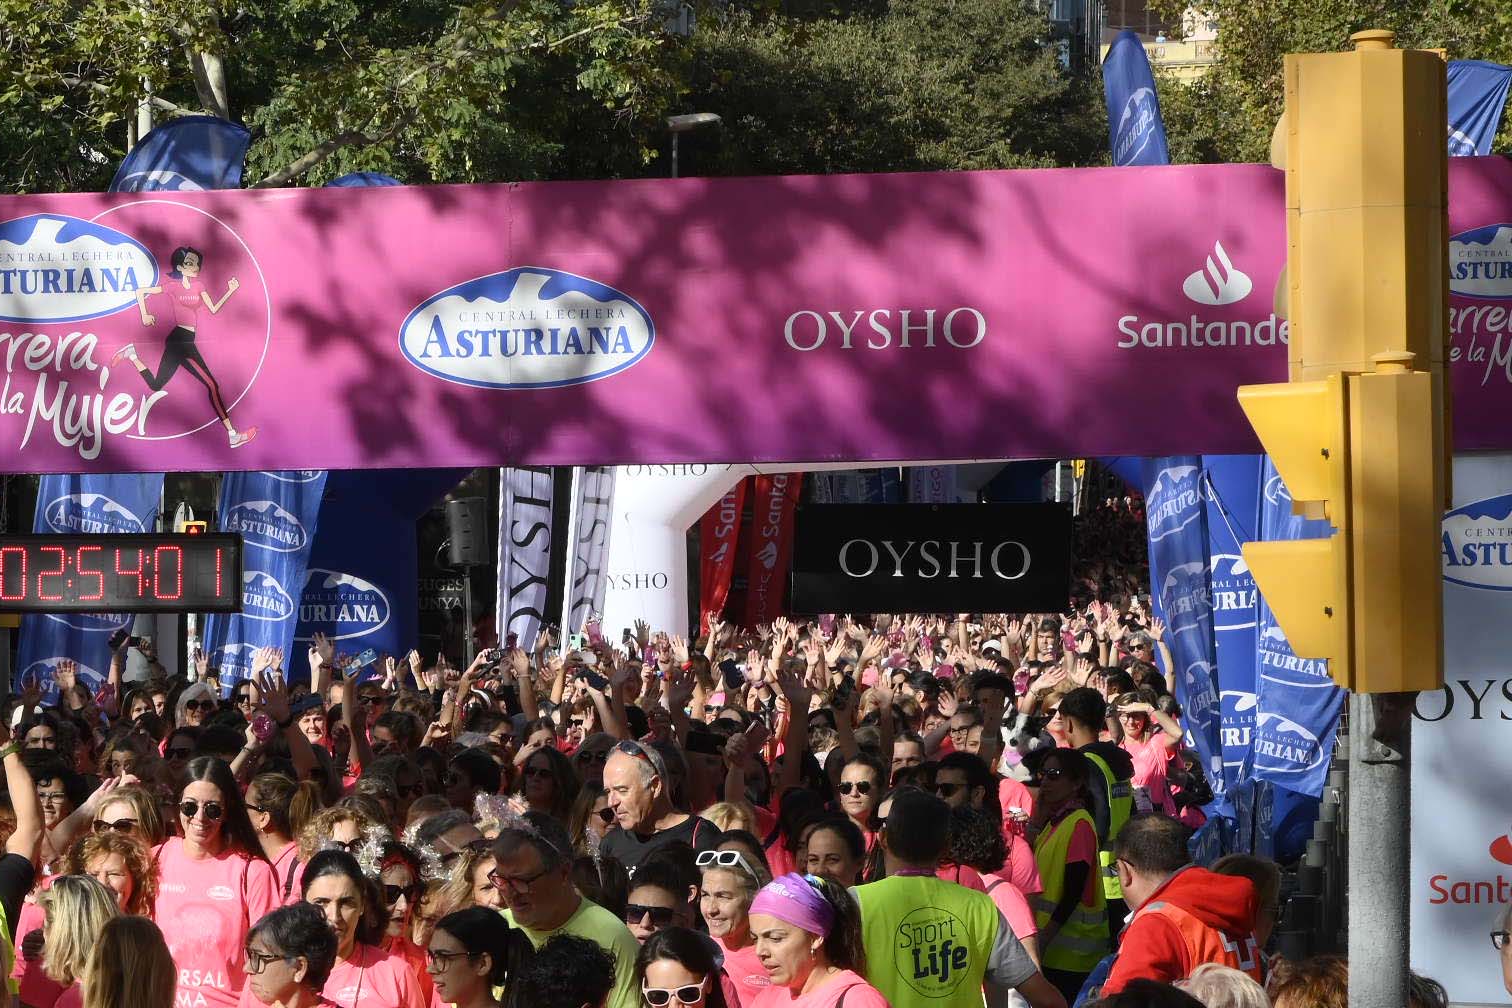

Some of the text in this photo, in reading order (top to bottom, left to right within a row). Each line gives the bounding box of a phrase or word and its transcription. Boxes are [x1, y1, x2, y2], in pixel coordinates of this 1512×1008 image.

[61, 251, 136, 262] LECHERA
[459, 307, 625, 322] CENTRAL LECHERA
[784, 306, 987, 351] OYSHO
[418, 314, 635, 360] ASTURIANA
[0, 375, 24, 414] la
[20, 366, 169, 460] Mujer
[228, 514, 300, 547] ASTURIANA
[0, 546, 222, 600] 02:54:01
[839, 539, 1032, 580] OYSHO
[900, 915, 956, 949] Sport
[911, 940, 968, 984] Life
